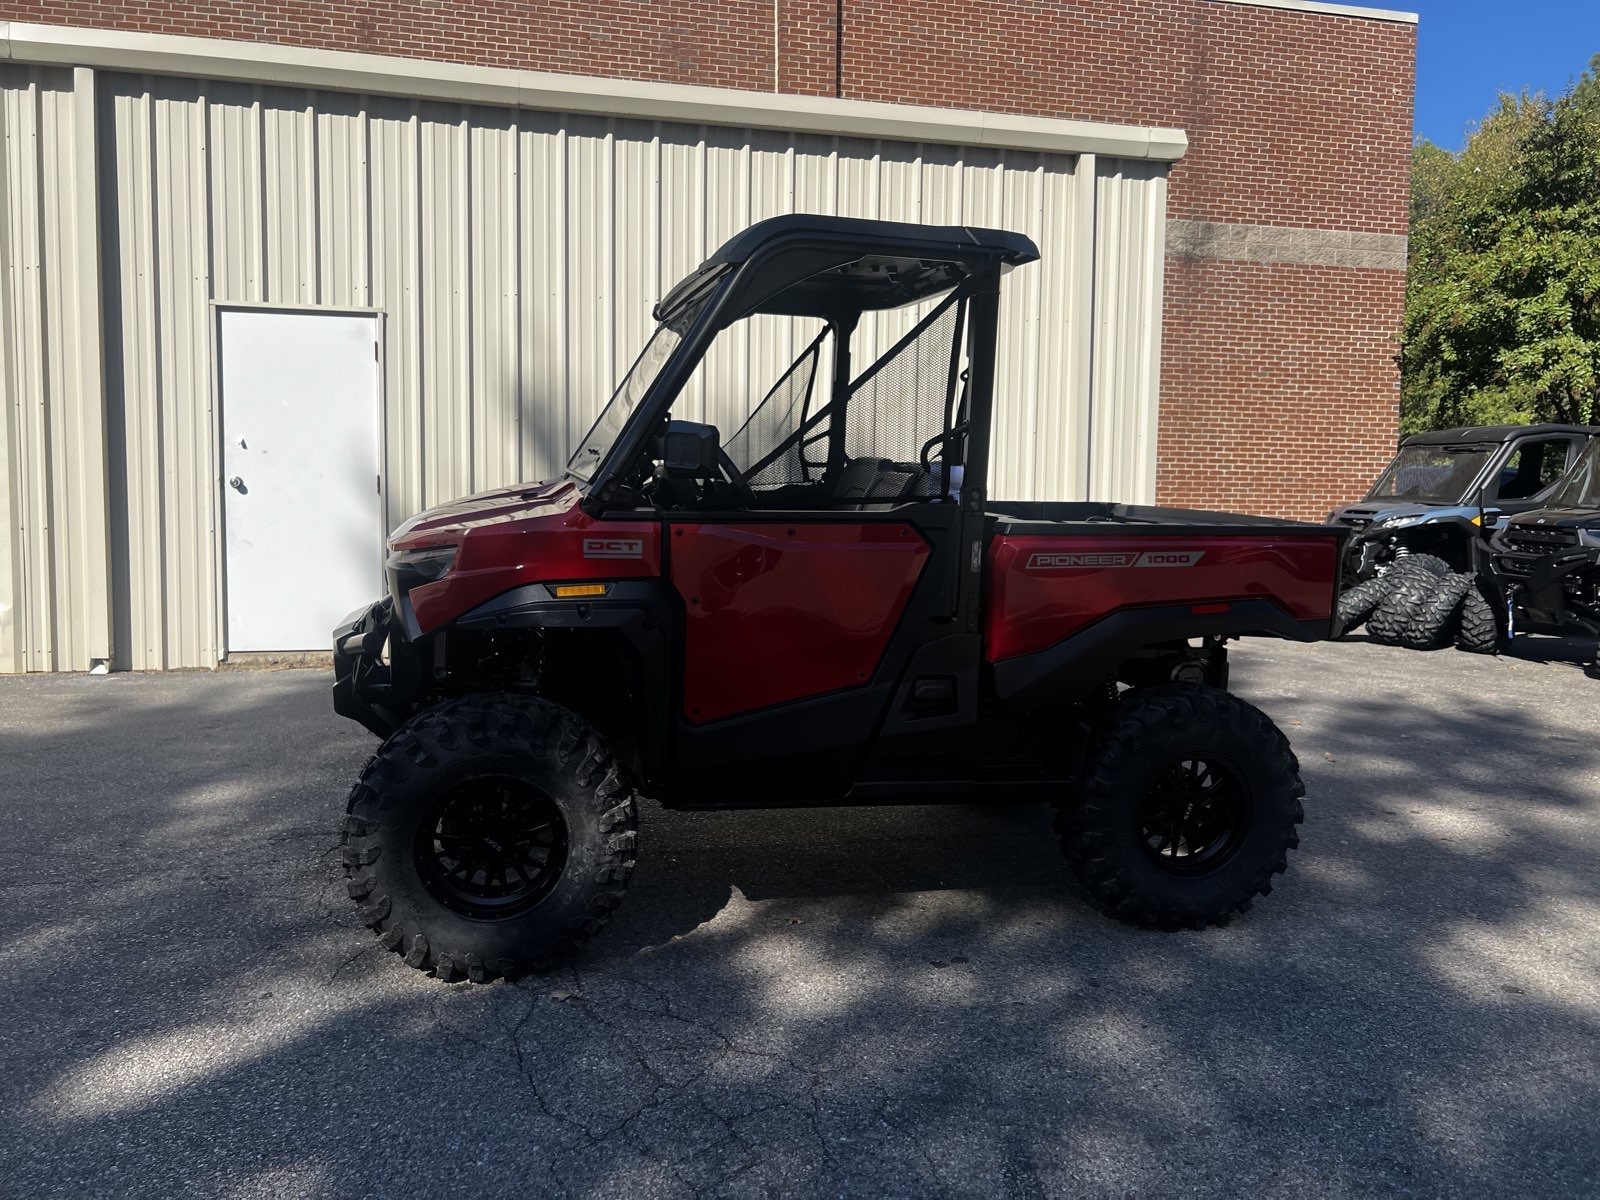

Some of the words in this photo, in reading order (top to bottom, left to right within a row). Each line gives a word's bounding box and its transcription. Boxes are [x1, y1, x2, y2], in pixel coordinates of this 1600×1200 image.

[587, 541, 639, 551] DCT
[1036, 554, 1127, 566] PIONEER
[1147, 554, 1190, 564] 1000
